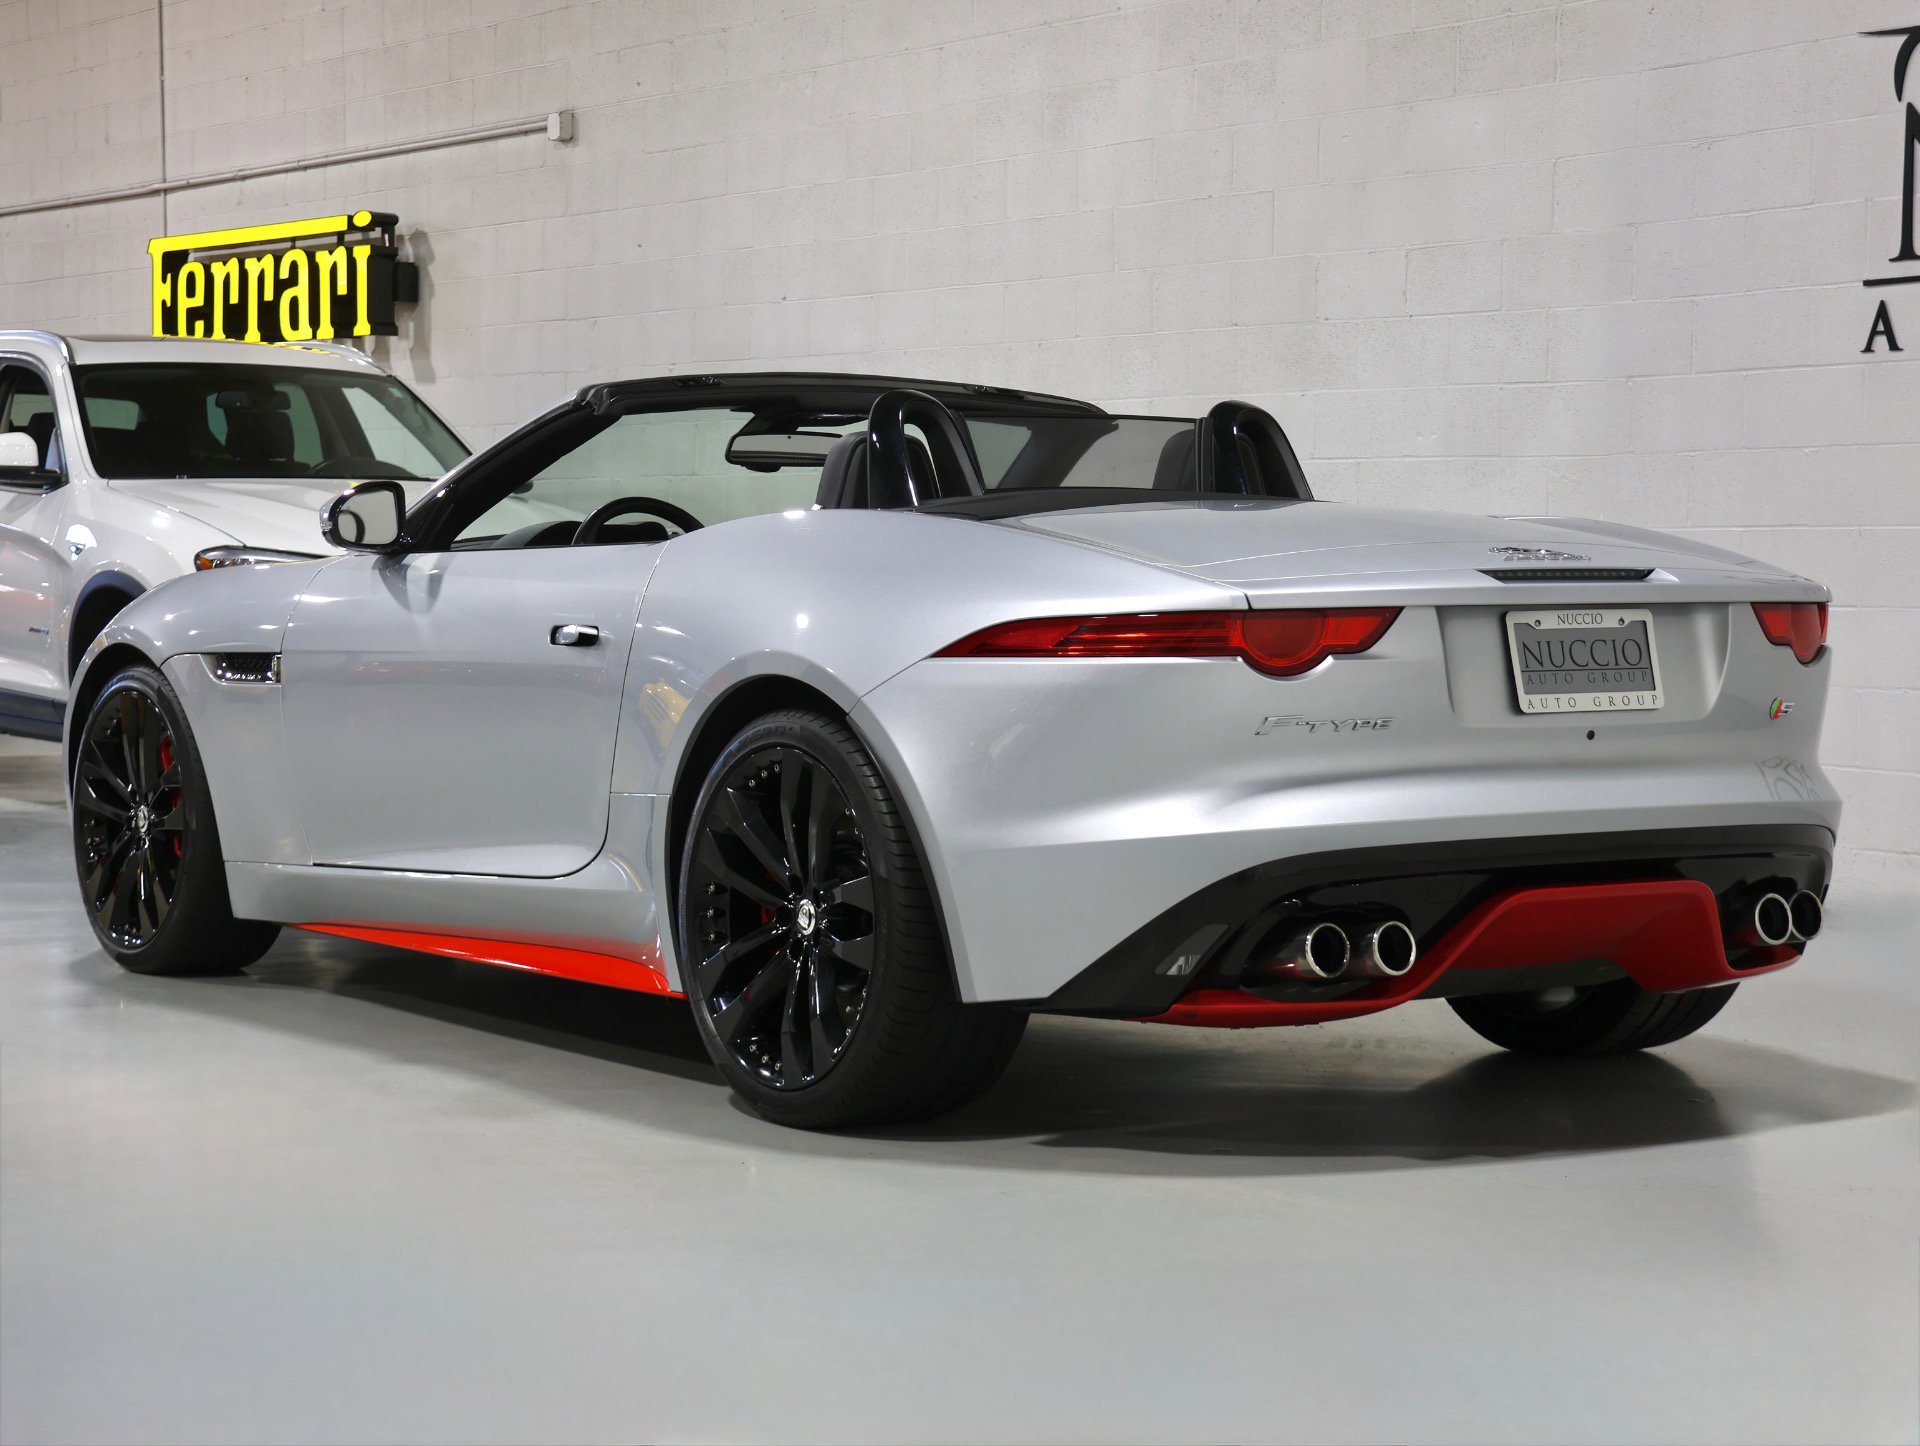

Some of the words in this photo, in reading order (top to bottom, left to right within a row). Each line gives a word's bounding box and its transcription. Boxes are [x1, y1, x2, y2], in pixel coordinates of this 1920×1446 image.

[148, 210, 372, 343] Ferrari
[1557, 612, 1603, 625] NUCCIO
[1521, 638, 1643, 669] NUCCIO
[1526, 672, 1574, 685] AUTO
[1587, 671, 1648, 684] GROUP
[1527, 697, 1577, 710] AUTO
[1593, 694, 1658, 708] GROUP
